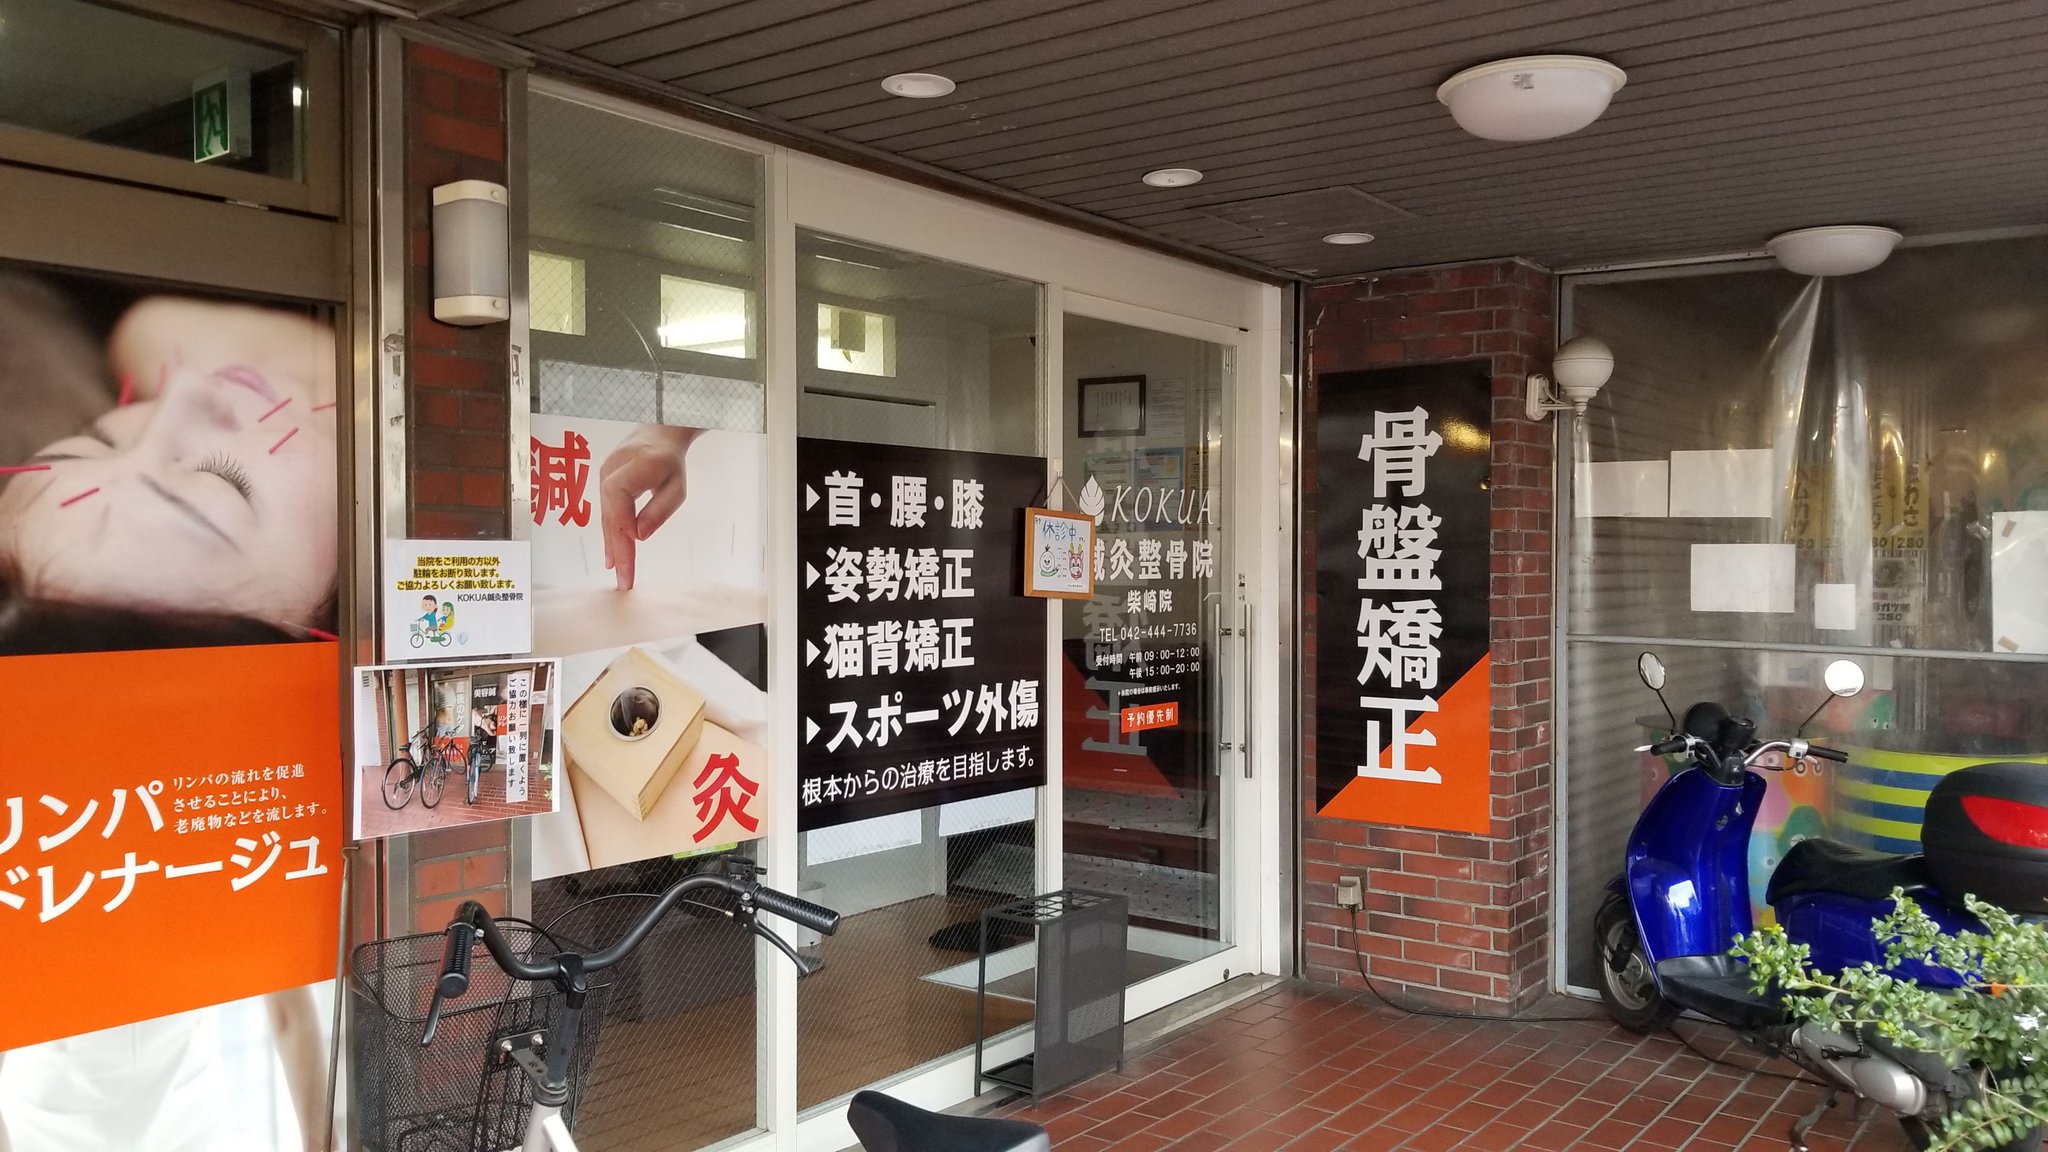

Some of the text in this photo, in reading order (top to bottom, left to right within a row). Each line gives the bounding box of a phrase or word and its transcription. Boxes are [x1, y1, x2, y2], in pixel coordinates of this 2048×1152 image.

[824, 470, 984, 529] 首・腰・膝
[1111, 485, 1213, 525] KOKUA
[1042, 520, 1077, 541] 休診中
[413, 568, 500, 579] 駐輪をお断り致します。
[417, 556, 501, 567] 当院をご利用の方以外
[824, 546, 975, 603] 姿勢矯正
[397, 579, 516, 591] ご協力よろしくお願い致します。
[1356, 405, 1443, 784] 骨盤矯正
[1127, 589, 1173, 614] 柴崎院
[1100, 623, 1198, 642] TEL 042-444-7736
[823, 618, 975, 679] 猫背矯正
[1095, 653, 1123, 667] 受付時間
[1129, 652, 1142, 663] 午前
[1129, 667, 1142, 679] 午後
[825, 679, 1039, 753] スポーツ外傷
[1127, 707, 1174, 727] 予約優先制
[508, 678, 517, 788] ご協力お願い致します
[518, 678, 528, 796] この様に一列に置くよう
[173, 763, 305, 791] リンパの流れを促進
[802, 745, 1034, 806] 根本からの治療を目指します。
[173, 787, 287, 813] させることにより、
[692, 752, 759, 843] 灸
[174, 802, 327, 834] 老廃物などを流します。
